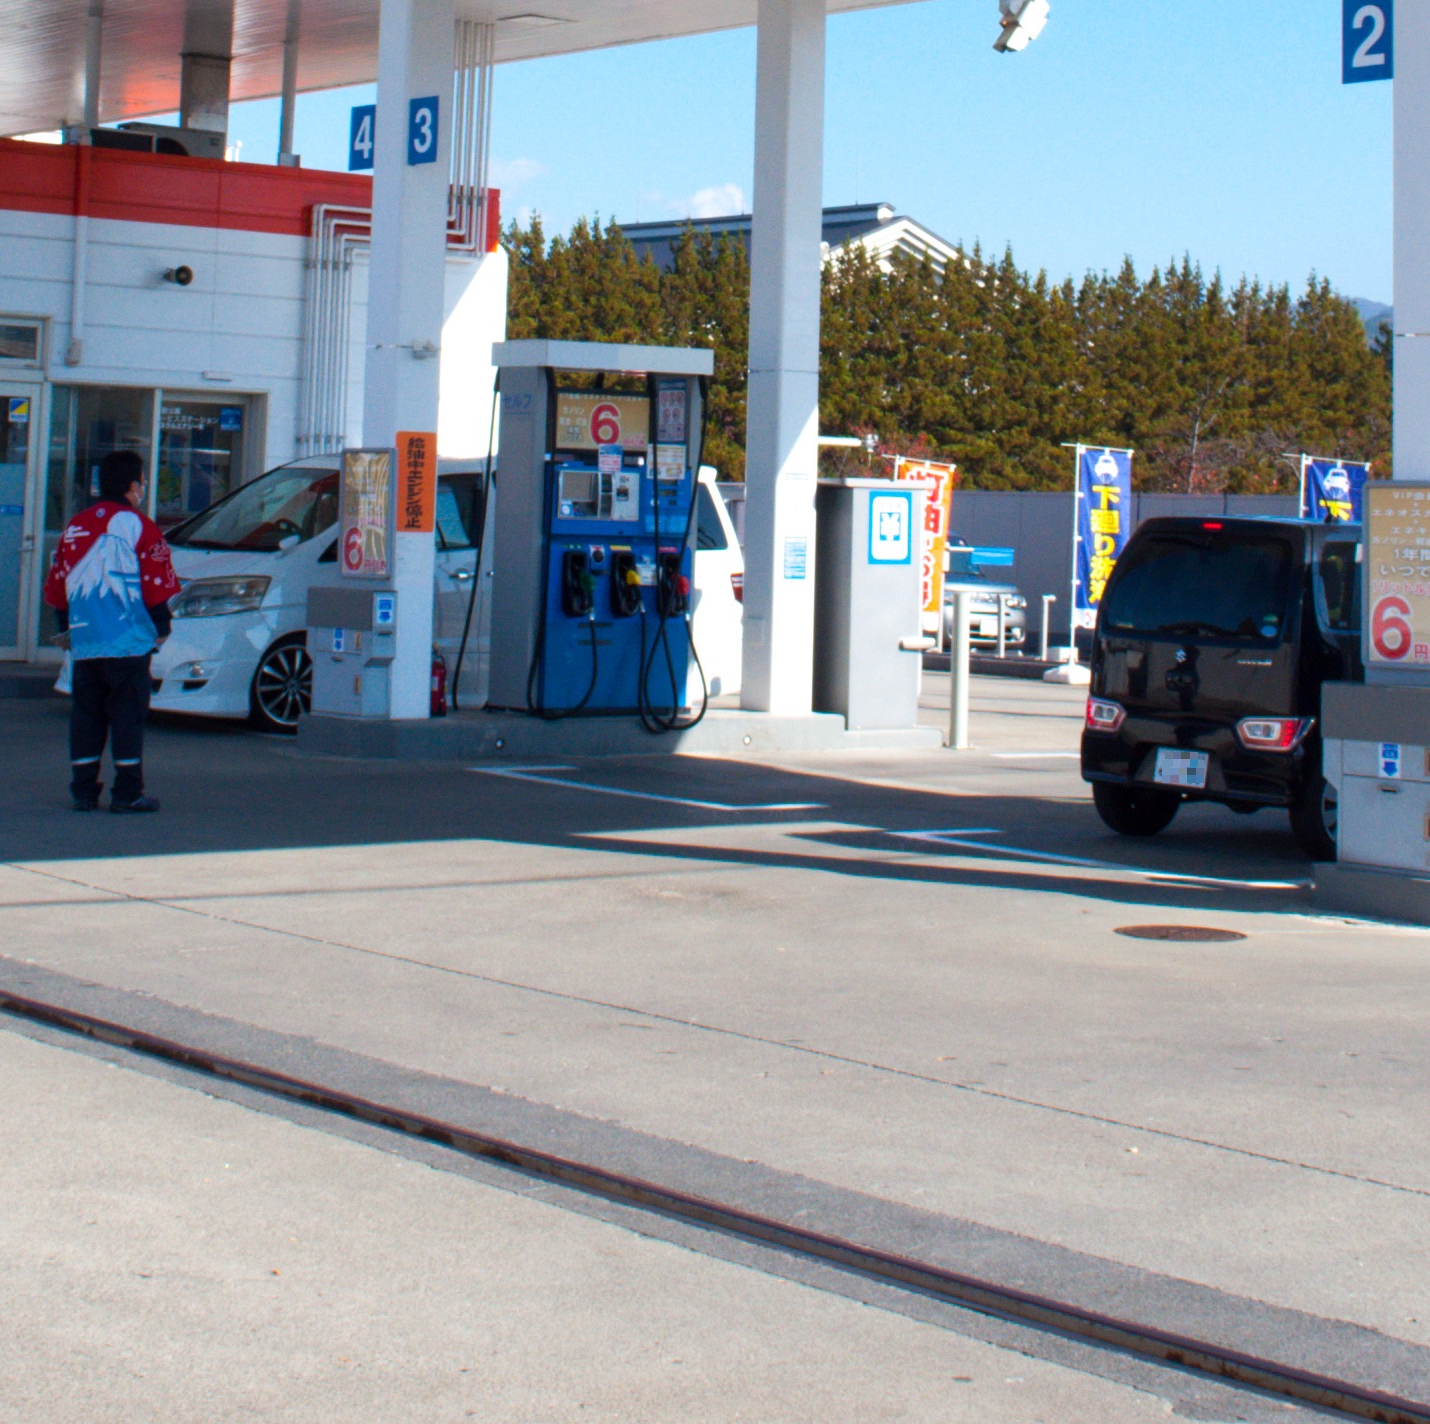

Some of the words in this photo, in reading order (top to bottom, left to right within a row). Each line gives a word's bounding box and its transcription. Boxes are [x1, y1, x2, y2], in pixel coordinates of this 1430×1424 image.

[1351, 4, 1386, 68] 2
[353, 115, 373, 159] 4
[413, 107, 432, 154] 3
[503, 393, 532, 410] セルフ
[590, 402, 620, 445] 6
[404, 436, 425, 529] 給油中エンジン停止
[344, 526, 364, 572] 6
[1372, 595, 1412, 661] 6
